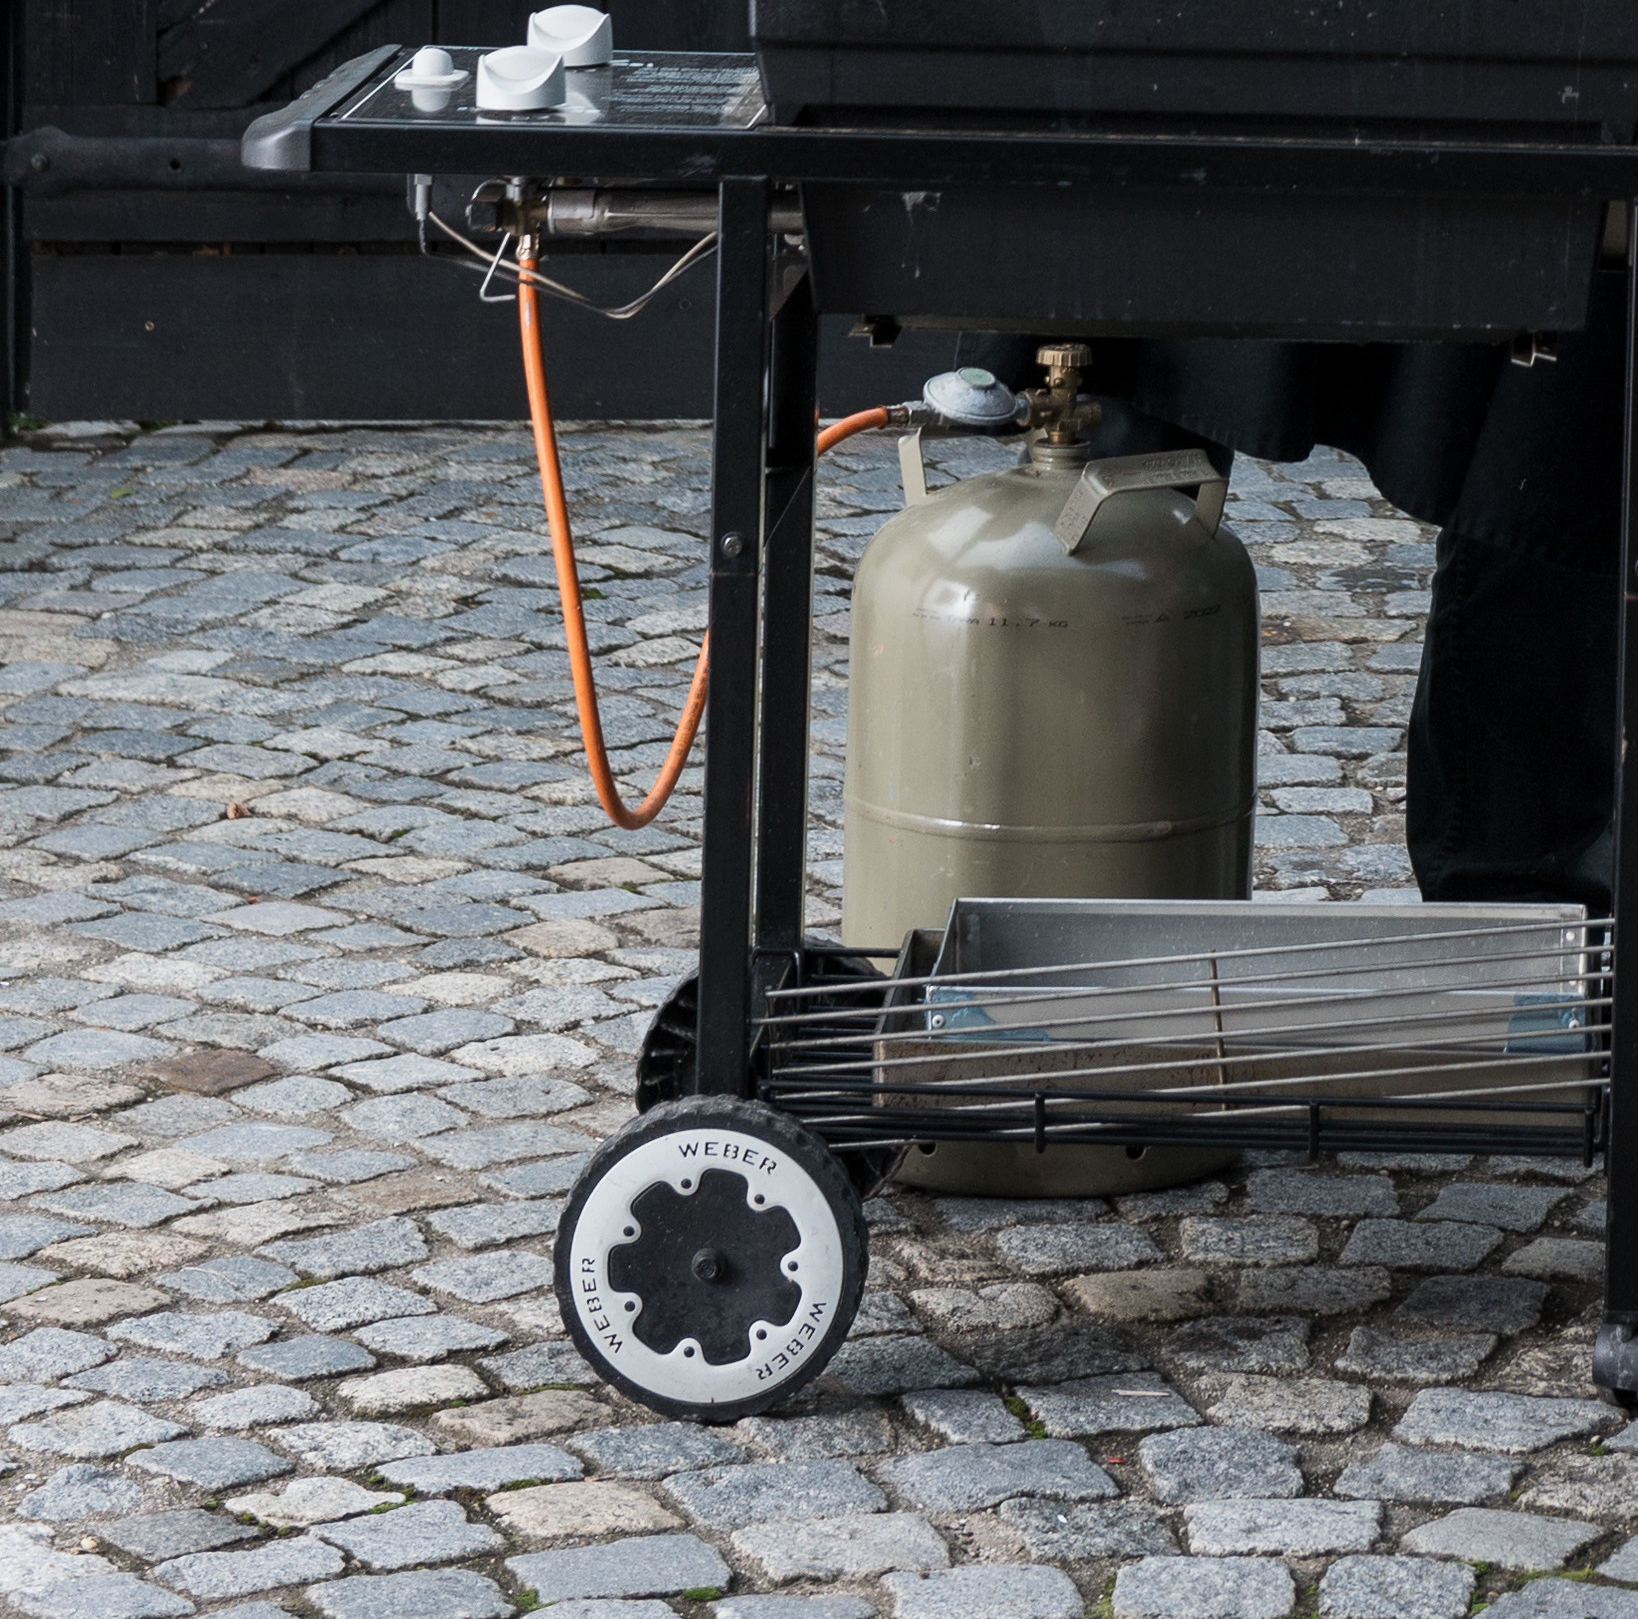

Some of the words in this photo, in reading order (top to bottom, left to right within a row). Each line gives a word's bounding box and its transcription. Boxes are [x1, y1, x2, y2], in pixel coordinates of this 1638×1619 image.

[678, 1141, 777, 1176] WEBER
[581, 1258, 623, 1354] WEBER
[756, 1302, 827, 1381] WEBER
